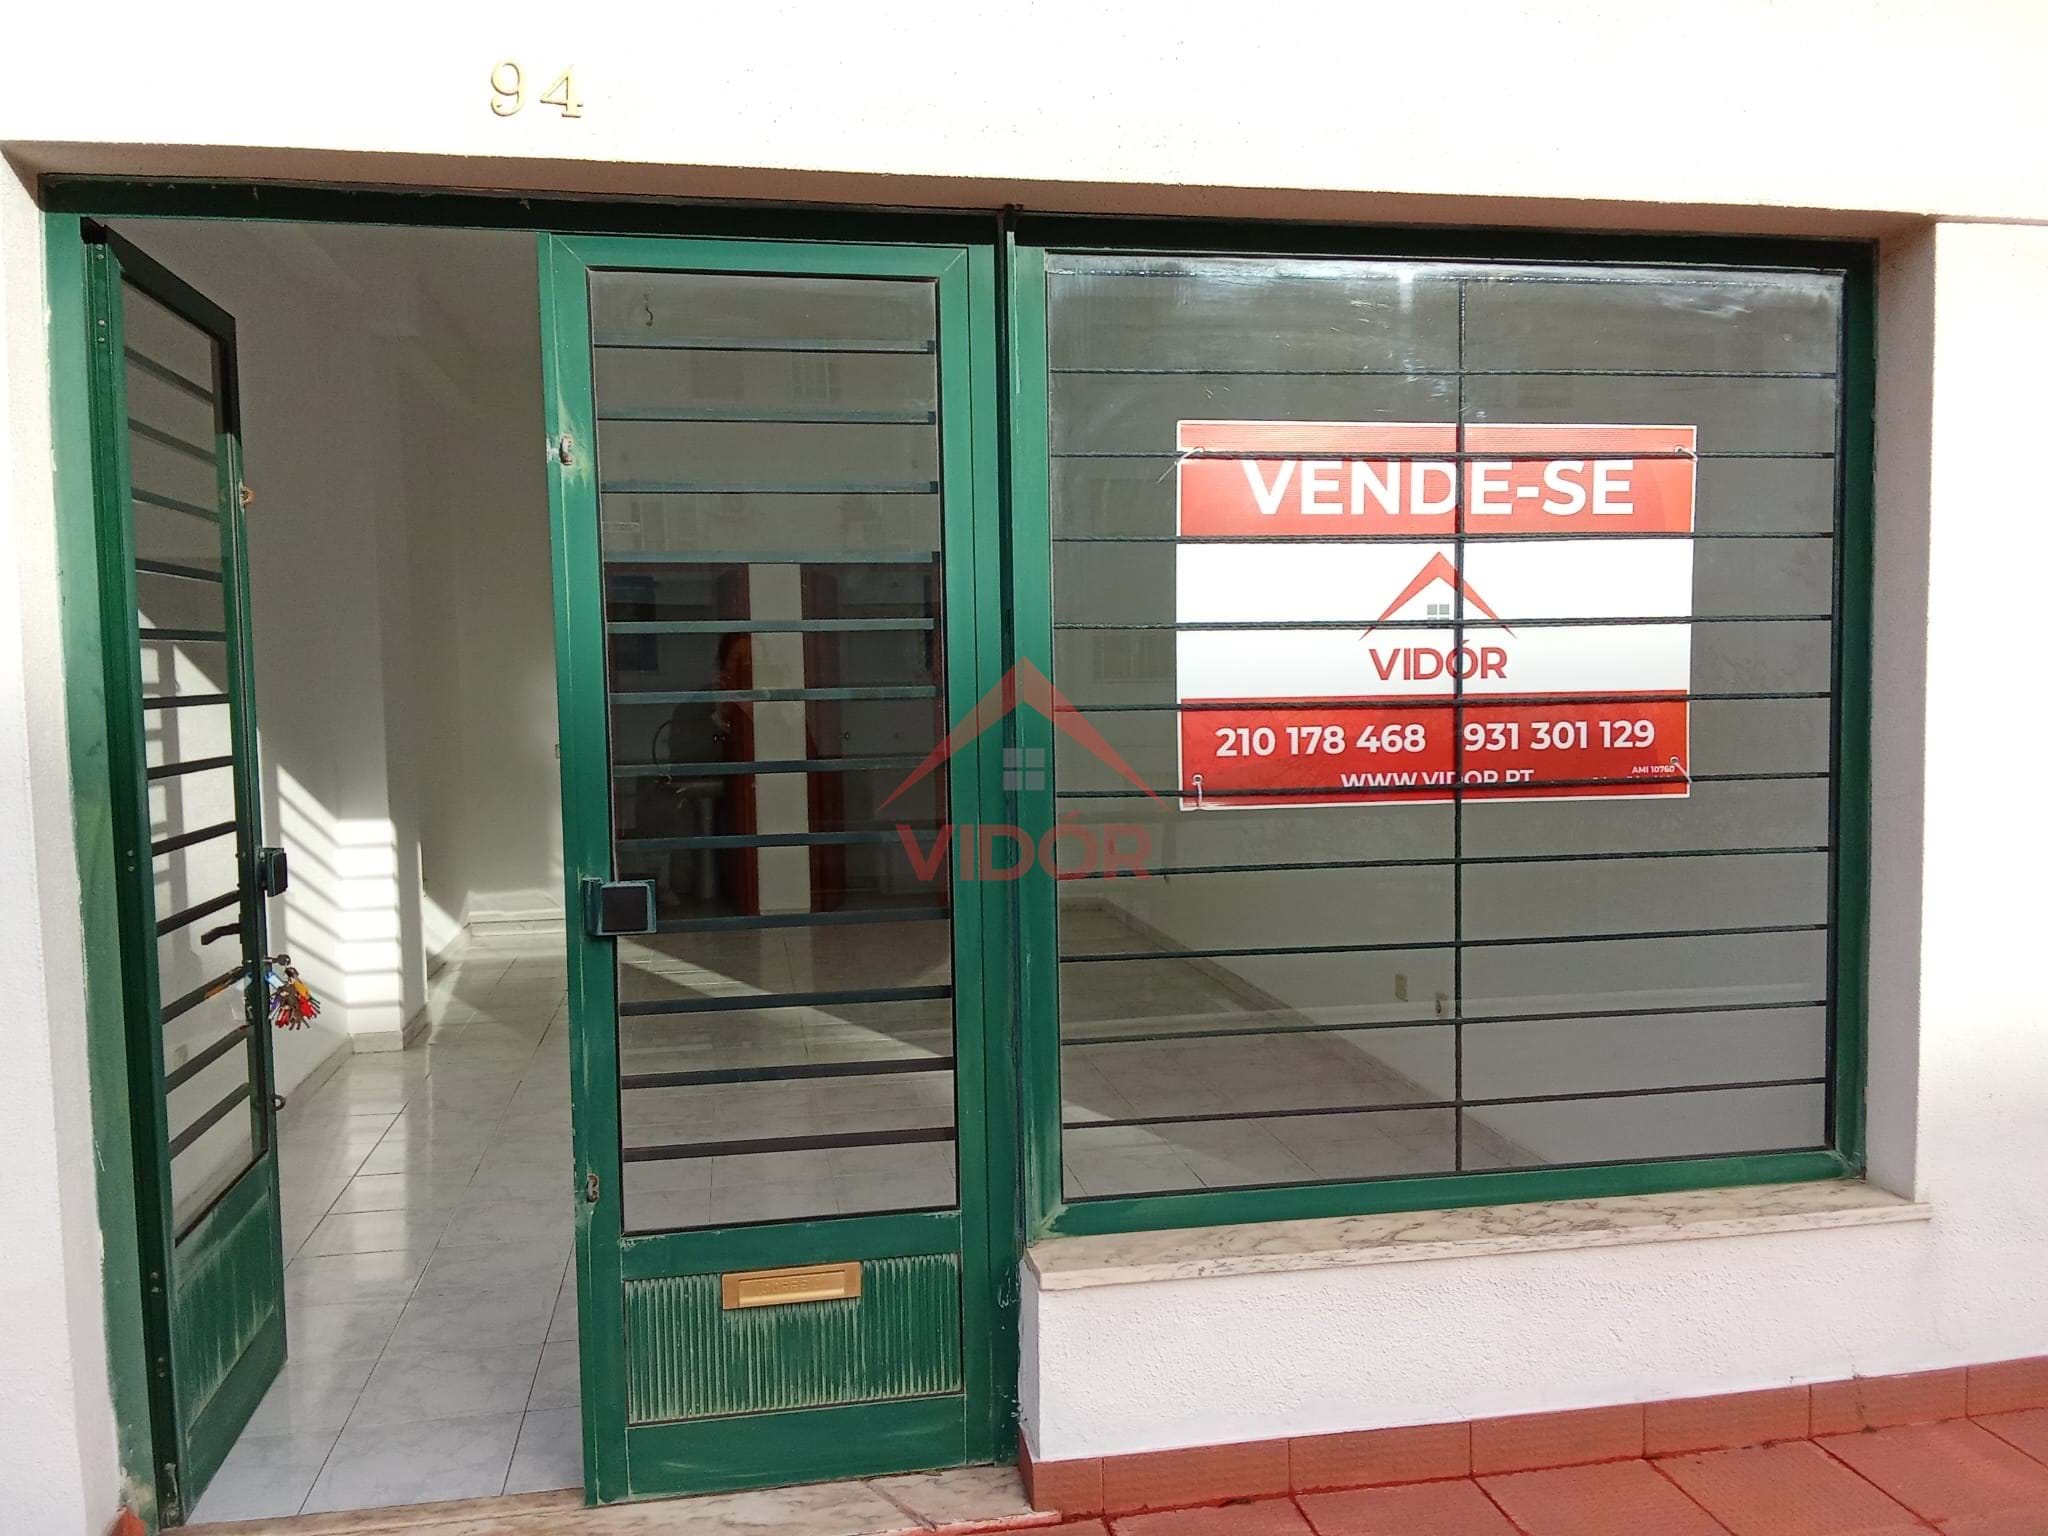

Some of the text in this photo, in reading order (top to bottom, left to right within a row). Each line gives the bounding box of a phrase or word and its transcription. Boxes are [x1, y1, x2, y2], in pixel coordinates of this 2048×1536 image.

[489, 60, 585, 119] 94
[1240, 458, 1635, 516] VENDE-SE
[1368, 639, 1508, 681] VIDÓR
[1215, 719, 1655, 757] 210 178 468 931 301 129
[1340, 769, 1535, 788] WWWVIORPT
[1631, 765, 1649, 774] AMI
